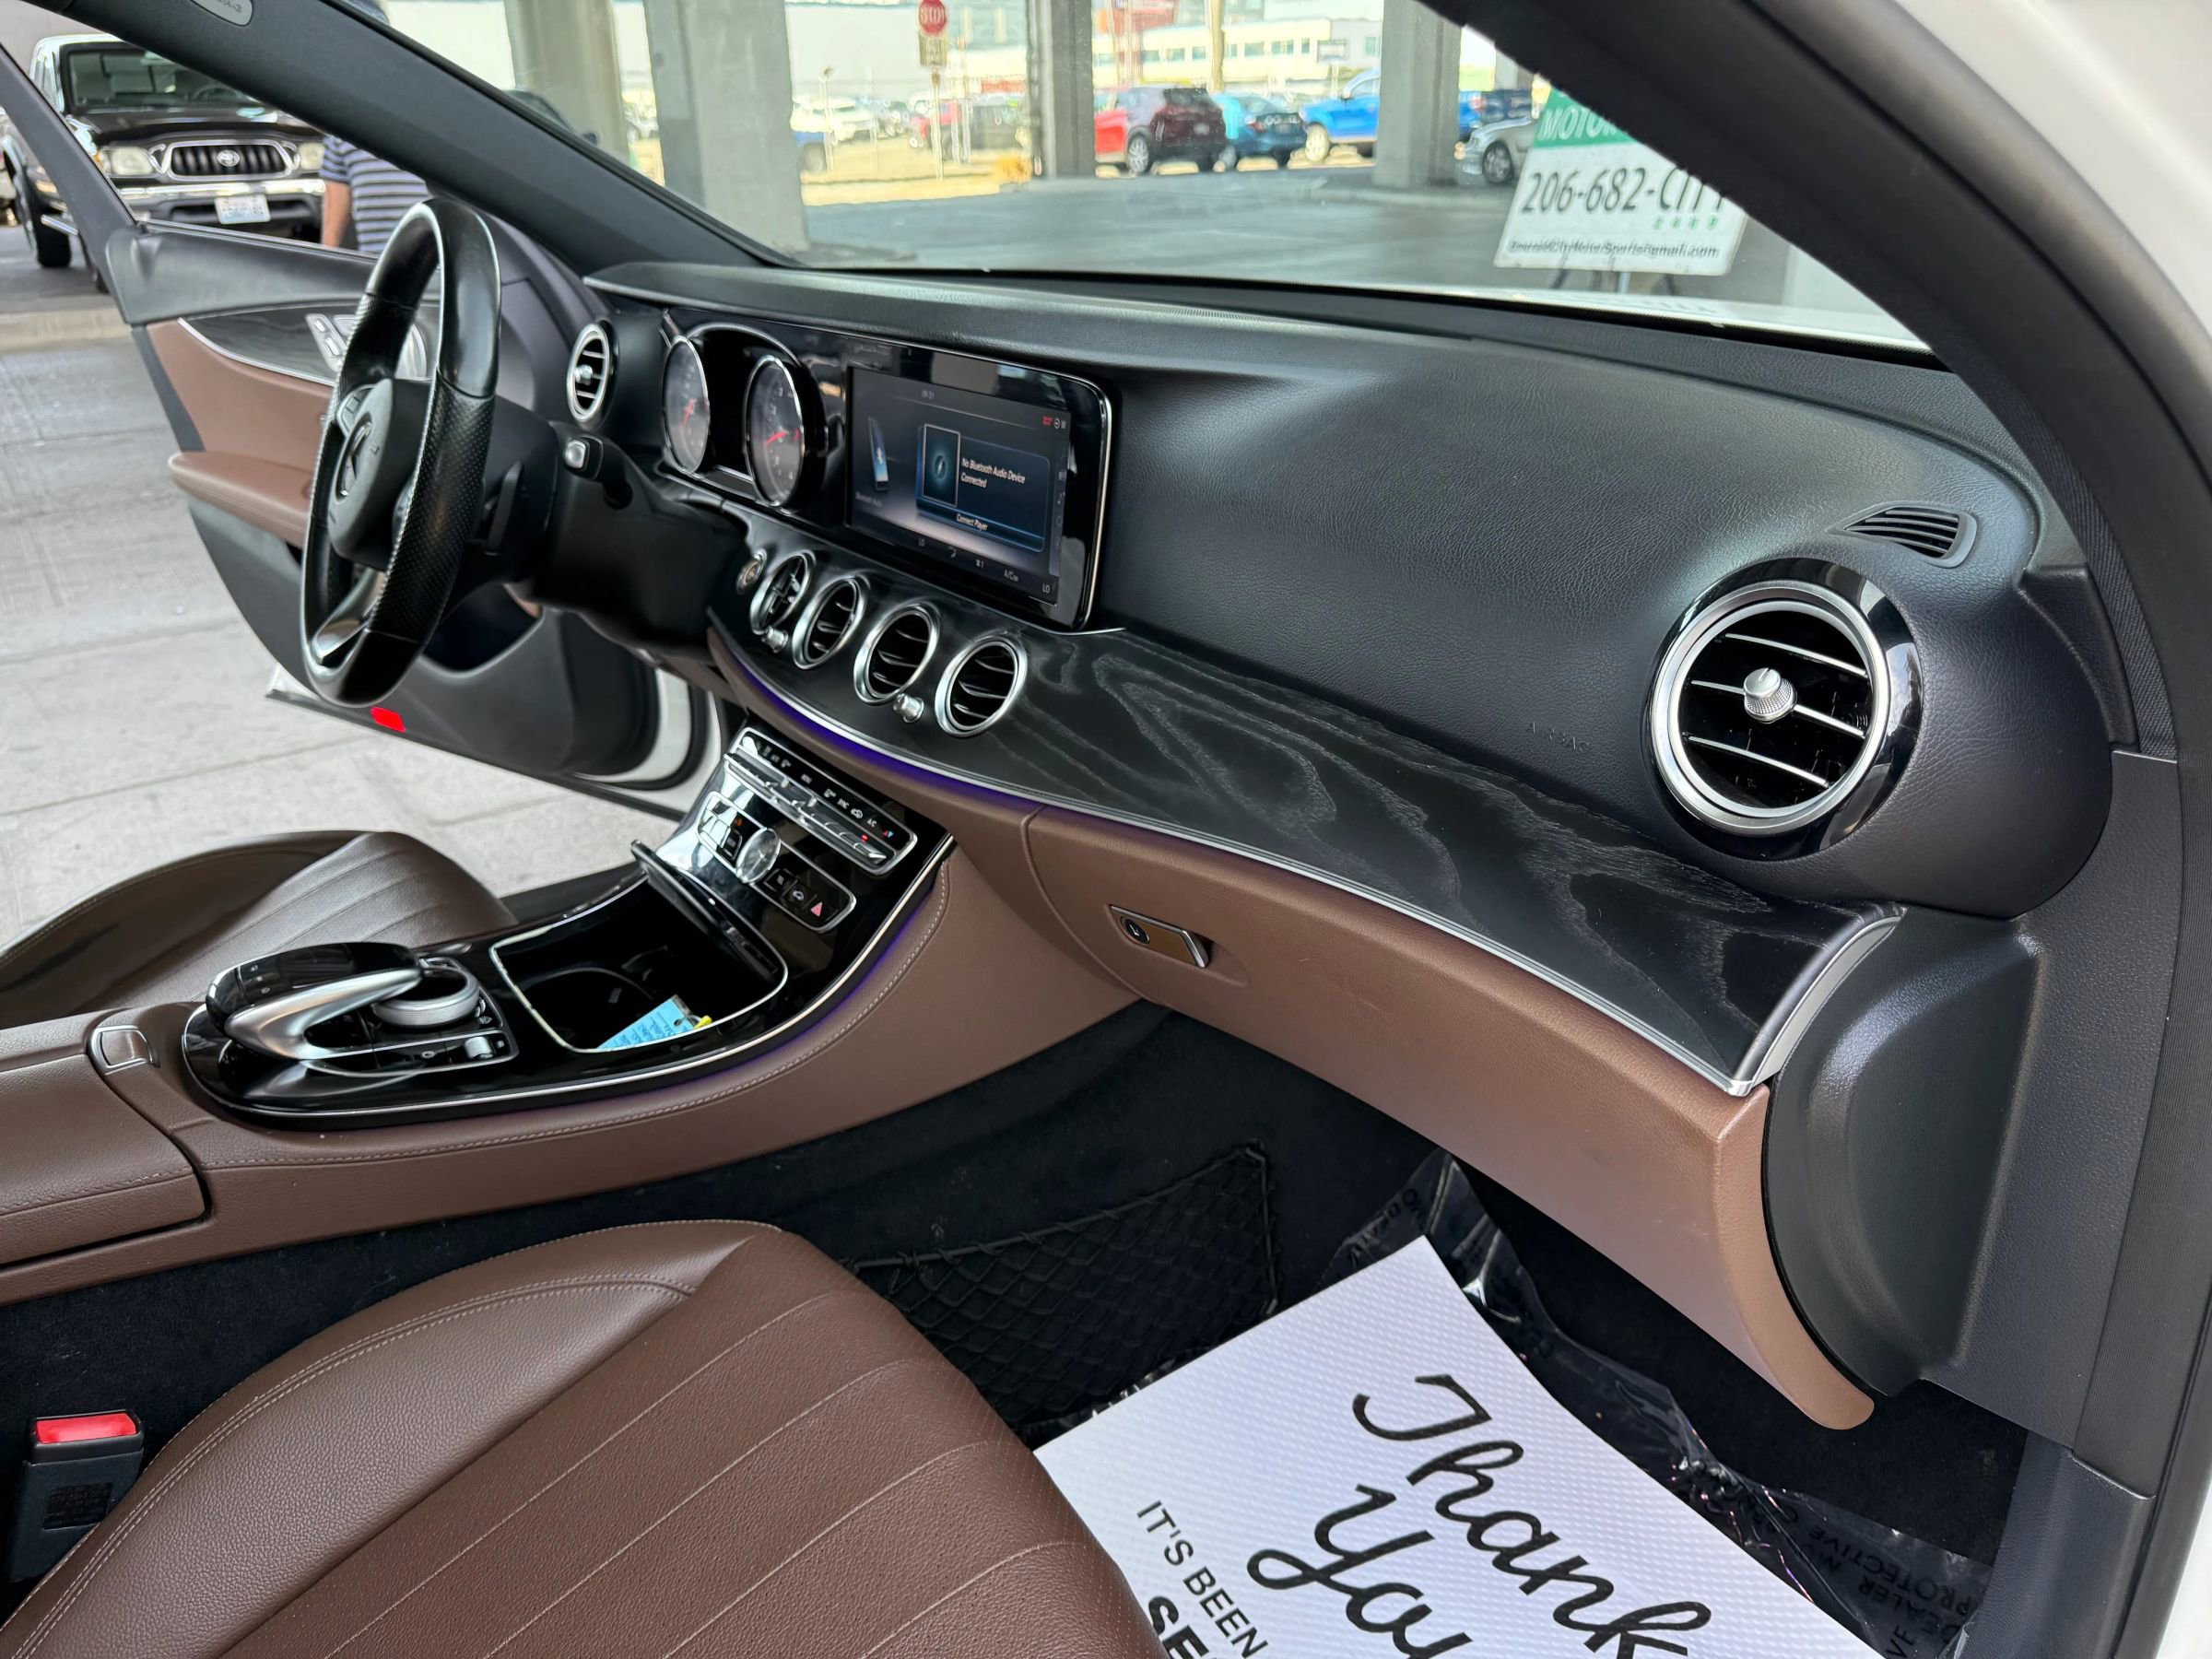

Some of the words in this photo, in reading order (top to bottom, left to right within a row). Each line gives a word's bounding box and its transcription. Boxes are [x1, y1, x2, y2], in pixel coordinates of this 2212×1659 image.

[1521, 166, 1723, 213] 206-682-CI
[960, 472, 988, 488] Connected
[961, 457, 970, 468] No
[970, 459, 993, 475] Bluetooth
[993, 465, 1007, 479] Audio
[1007, 469, 1026, 484] Device
[1352, 1373, 1712, 1659] Thank
[1136, 1500, 1194, 1566] IT'S
[1182, 1566, 1269, 1659] BEEN
[1807, 1524, 1972, 1617] PROTECTIVE
